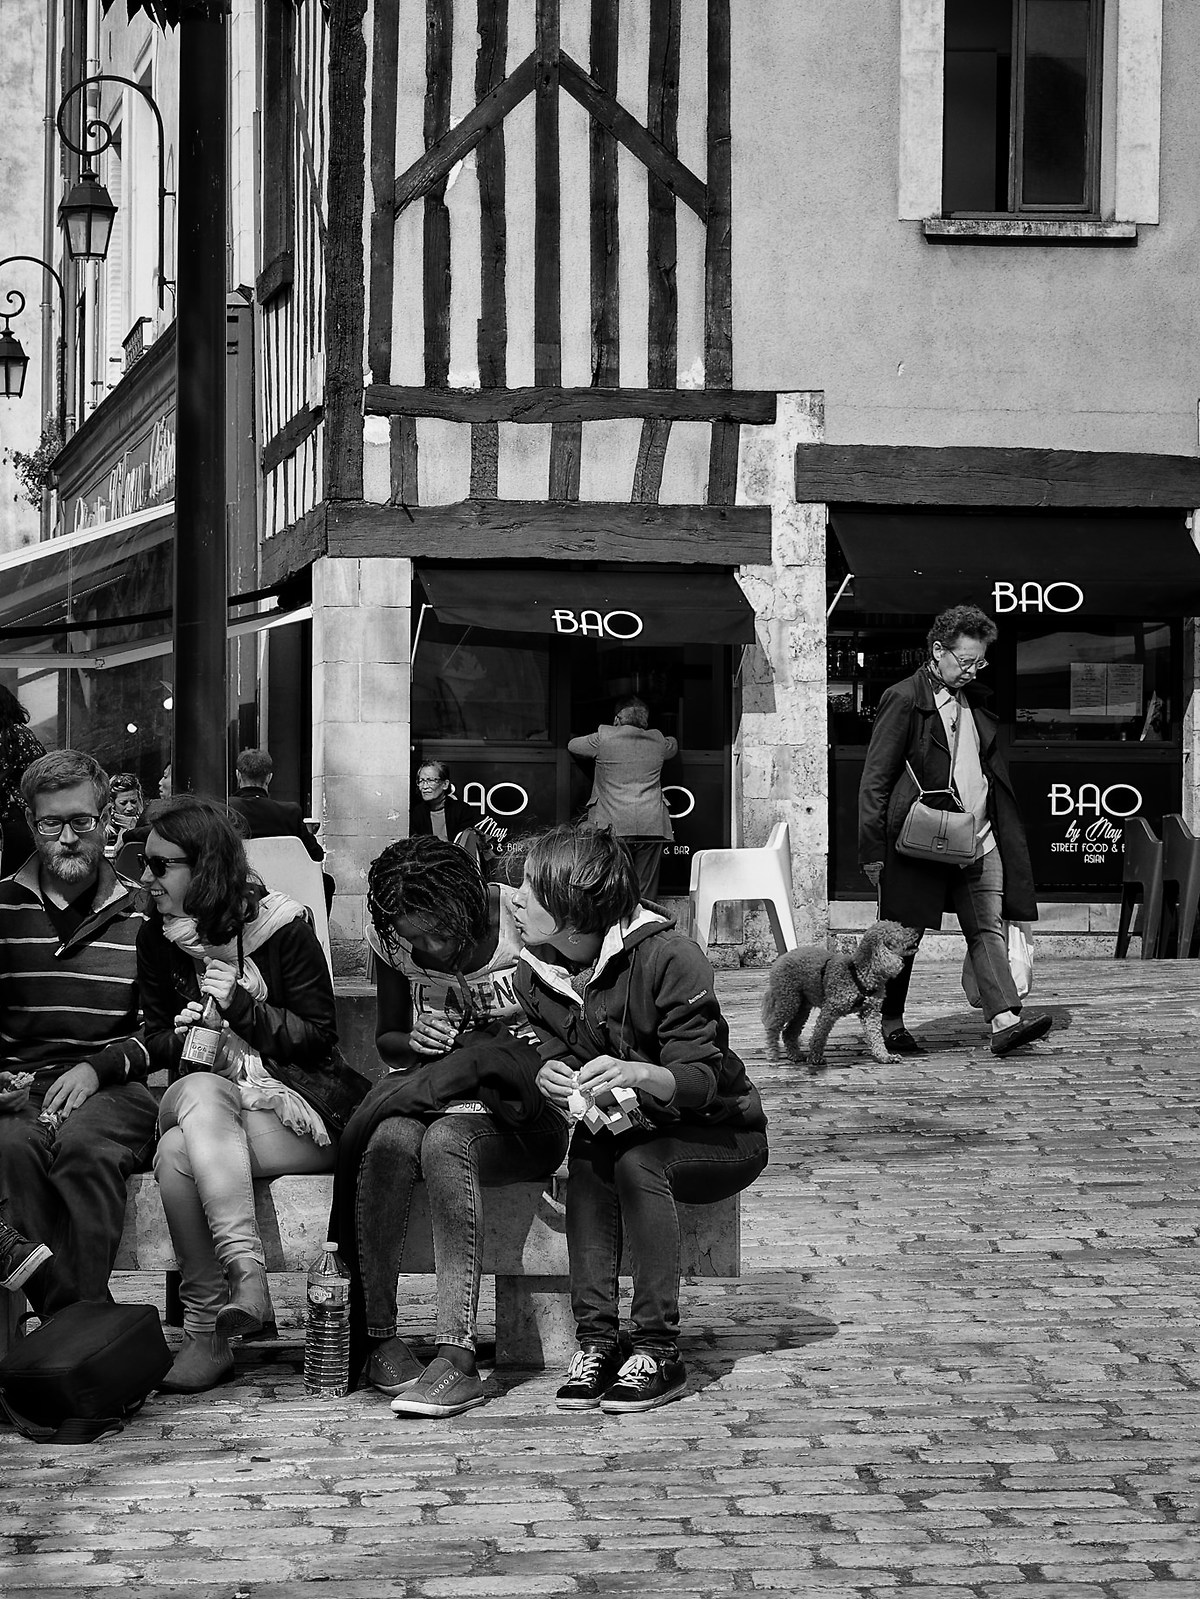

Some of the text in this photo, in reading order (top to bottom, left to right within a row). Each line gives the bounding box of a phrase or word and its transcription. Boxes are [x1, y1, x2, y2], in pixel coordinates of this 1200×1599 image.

[991, 581, 1084, 613] BAO
[551, 609, 644, 639] BAO
[1047, 783, 1143, 817] BAO
[1065, 816, 1123, 843] by May
[663, 845, 690, 855] & BAR
[1050, 842, 1079, 853] STREET
[1081, 842, 1109, 853] FOOD
[1111, 843, 1118, 853] &
[1083, 853, 1105, 864] ASIAN
